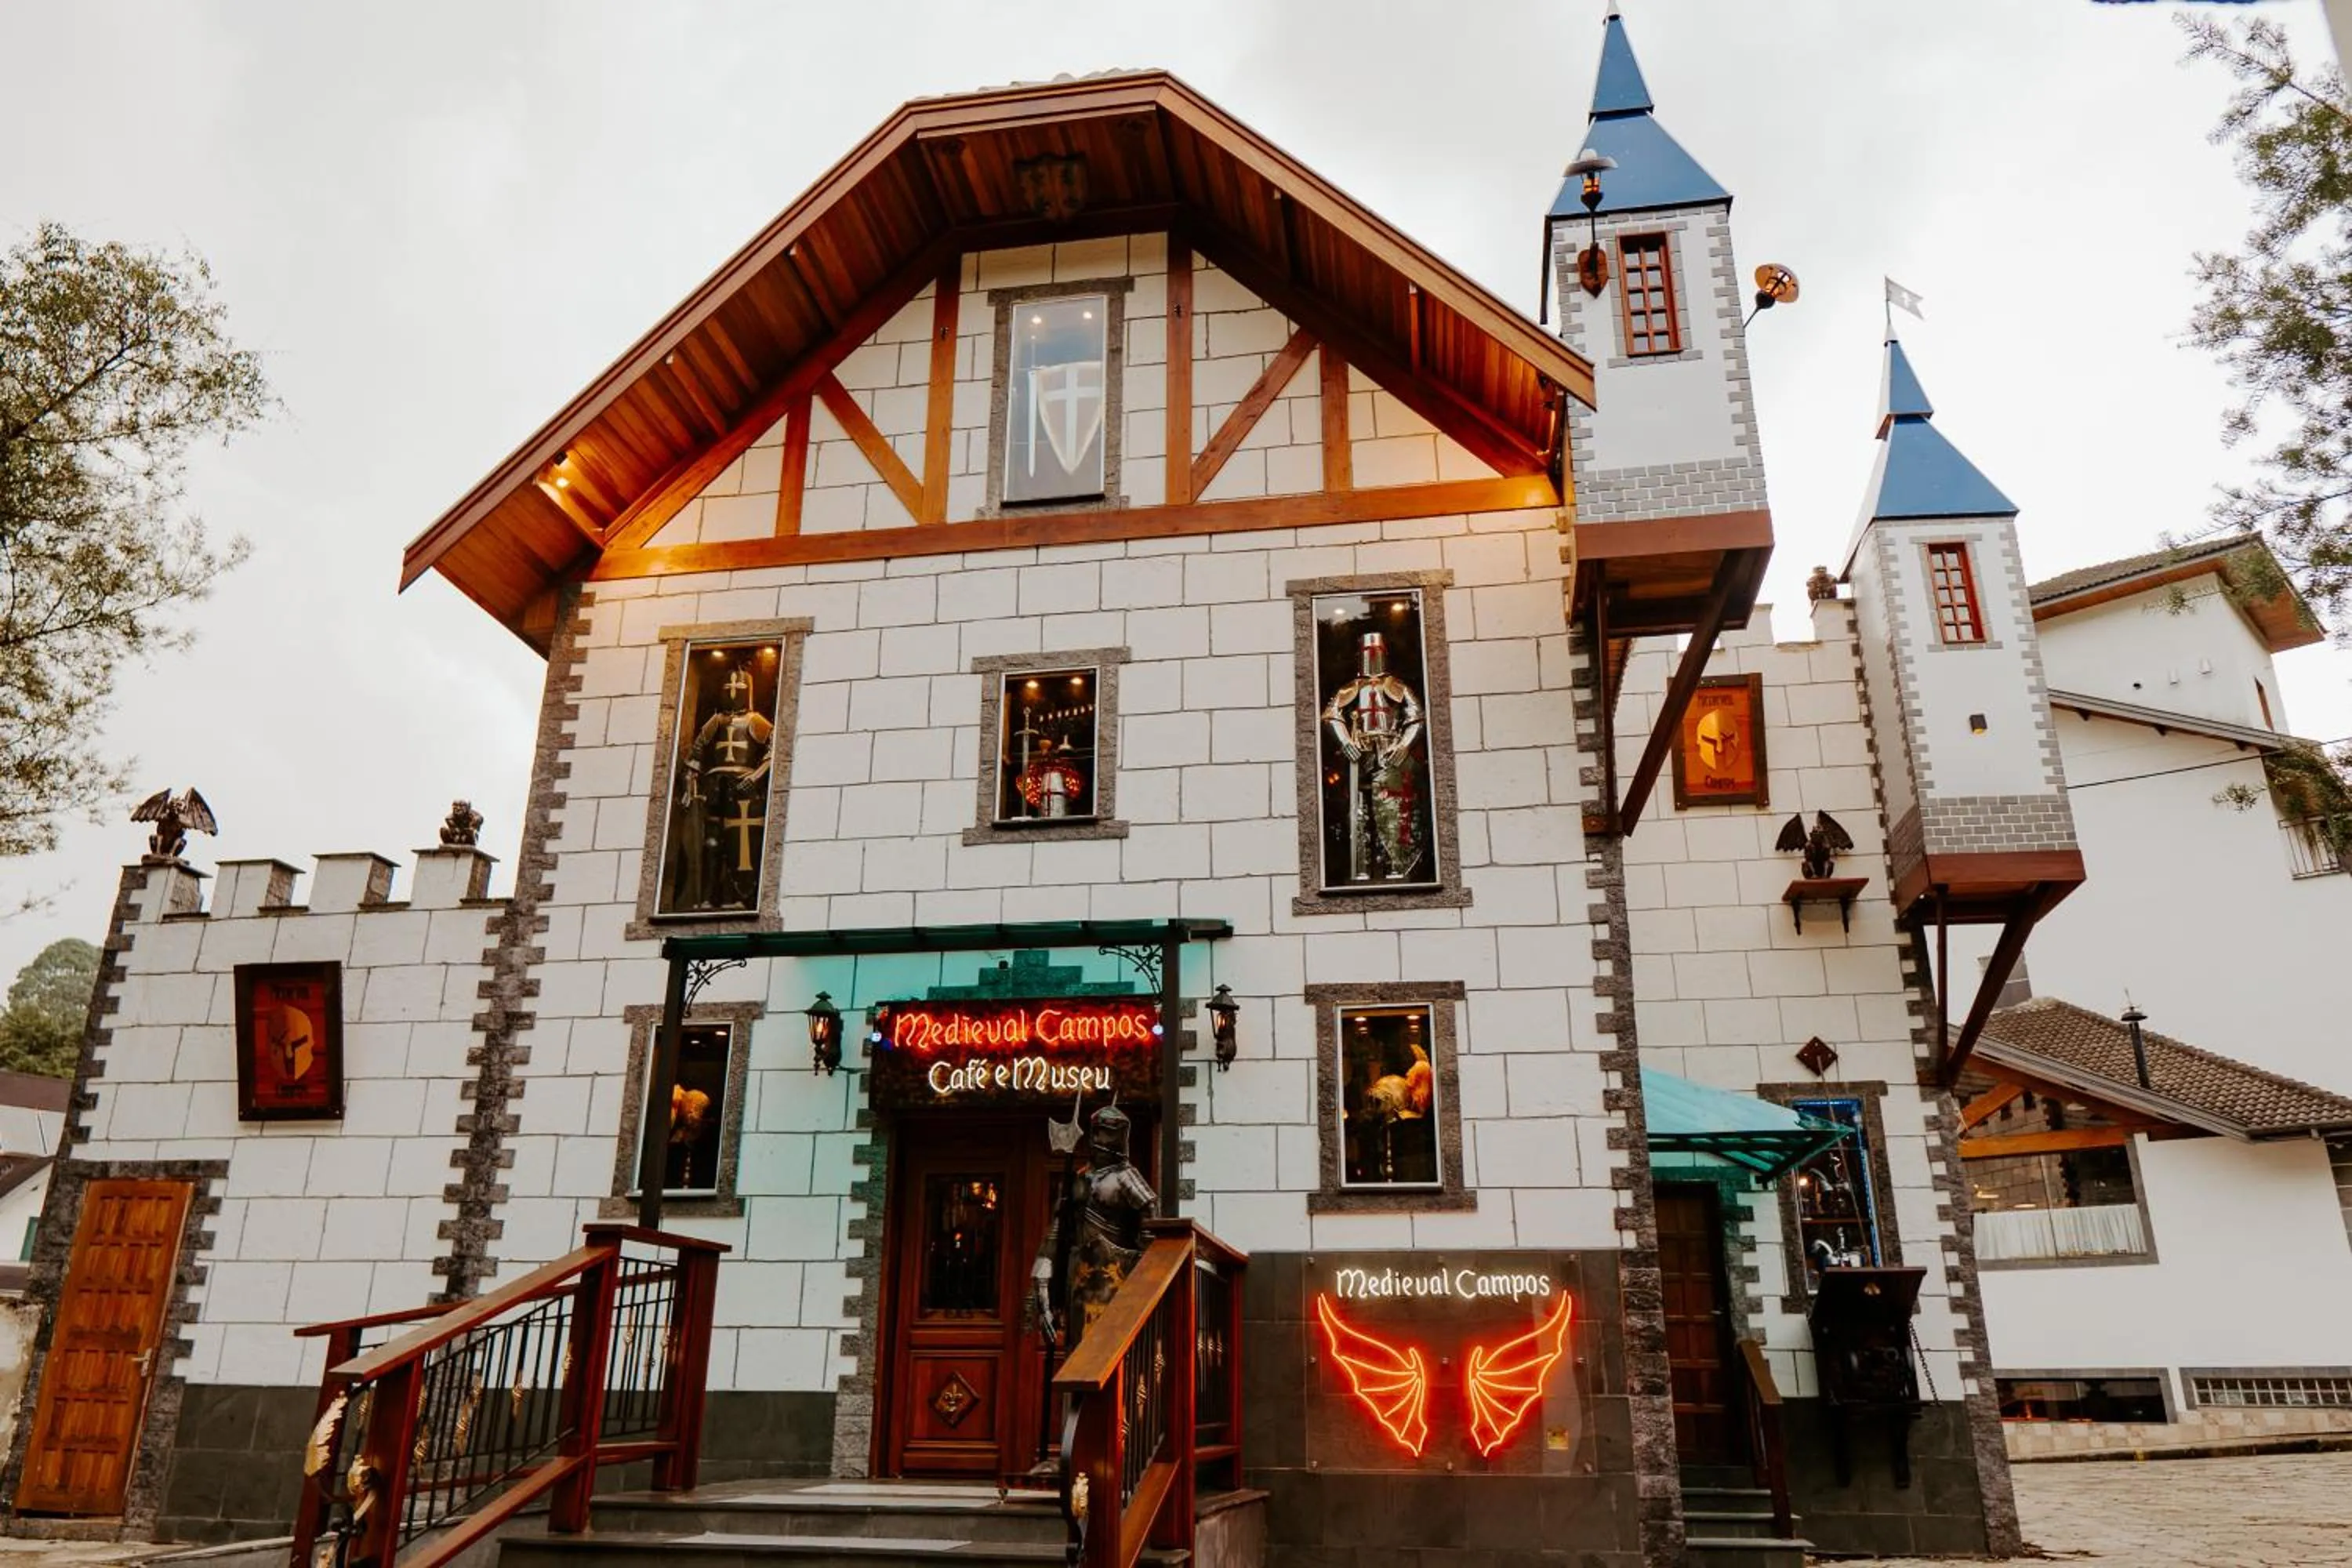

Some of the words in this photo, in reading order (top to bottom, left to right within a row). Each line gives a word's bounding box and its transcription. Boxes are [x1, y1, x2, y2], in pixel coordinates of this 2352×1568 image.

[895, 1009, 1029, 1048] Medieval
[1035, 1008, 1149, 1047] Campos
[927, 1058, 989, 1094] Café
[994, 1065, 1009, 1087] e
[1012, 1055, 1111, 1091] Museu
[1336, 1268, 1452, 1298] Medieval
[1455, 1269, 1551, 1302] Campos
